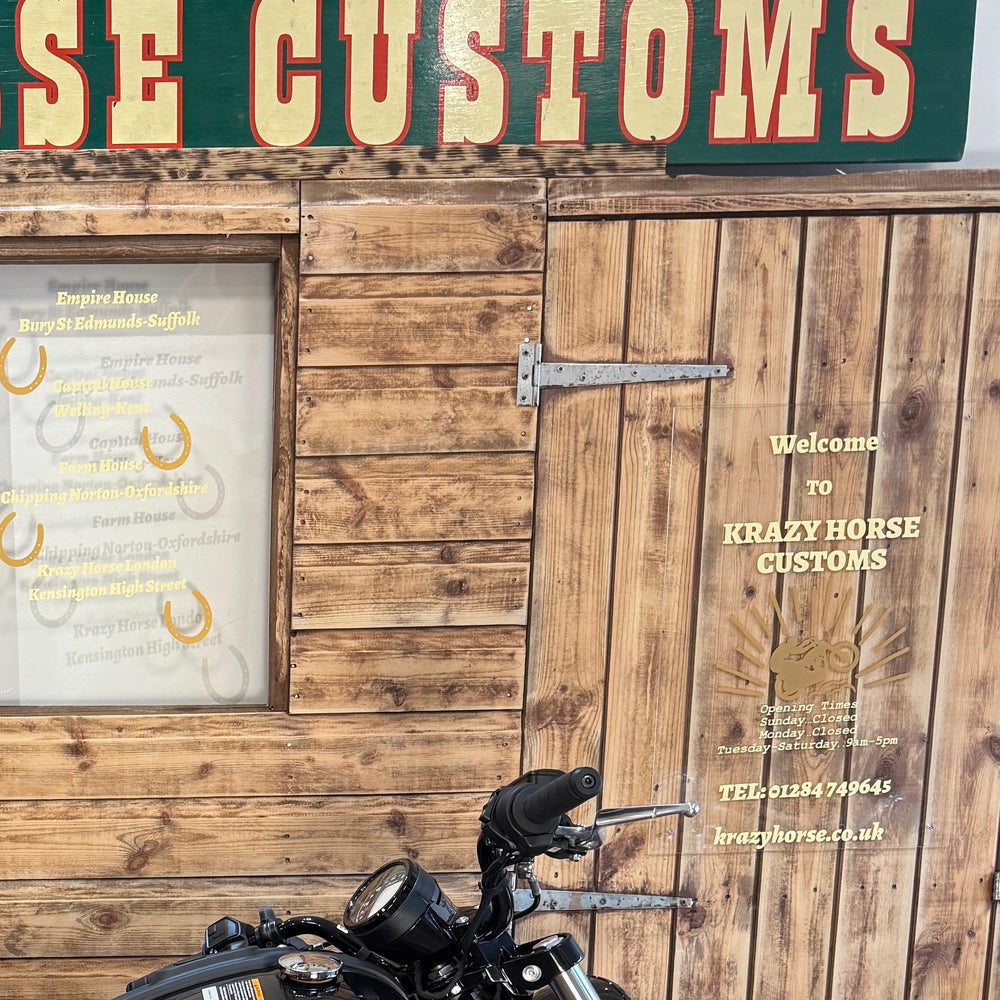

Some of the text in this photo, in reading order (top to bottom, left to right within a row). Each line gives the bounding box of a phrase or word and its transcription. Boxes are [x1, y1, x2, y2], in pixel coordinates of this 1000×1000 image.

[249, 0, 914, 147] CUSTOMS
[56, 290, 158, 309] Empire House
[19, 317, 56, 336] Bury
[56, 316, 72, 331] St
[74, 311, 201, 332] Edmunds-Suffolk
[770, 432, 878, 455] Welcome
[58, 458, 143, 475] Farm House
[0, 489, 67, 507] Chipping
[69, 480, 208, 502] Norton-Oxfordshire
[806, 480, 832, 496] TO
[722, 516, 921, 545] KRAZY HORSE
[36, 557, 176, 579] Krazy Horse London
[756, 548, 888, 574] CUSTOMS
[28, 578, 188, 602] Kensington High Street
[760, 700, 858, 716] Opening Times
[825, 778, 892, 798] 749645
[713, 822, 884, 849] krazyhorse.co.uk
